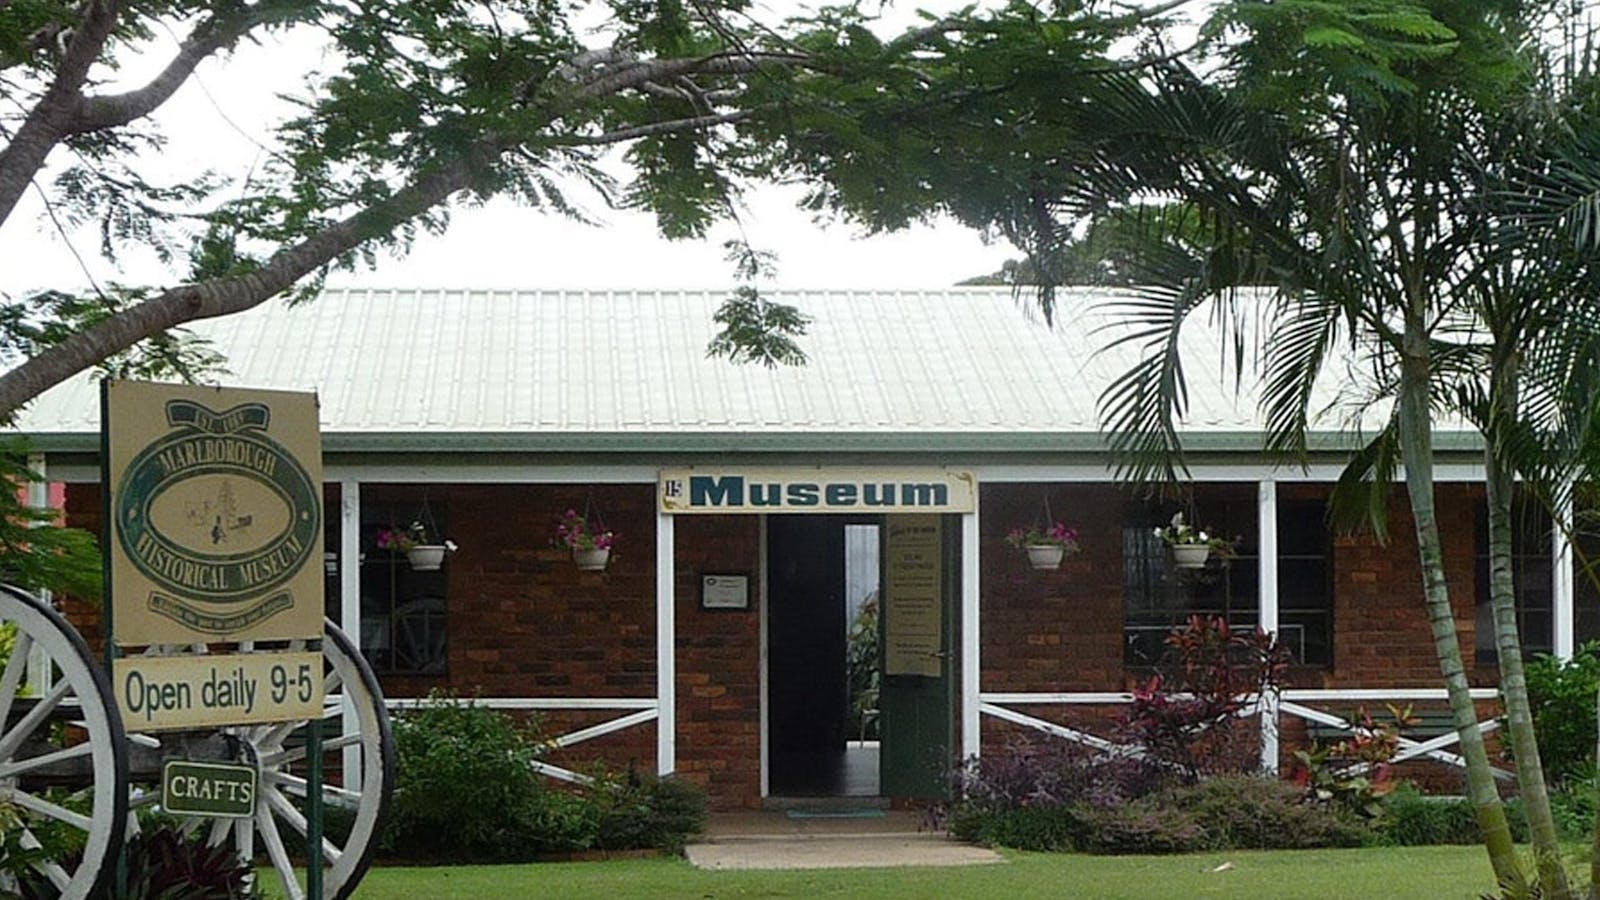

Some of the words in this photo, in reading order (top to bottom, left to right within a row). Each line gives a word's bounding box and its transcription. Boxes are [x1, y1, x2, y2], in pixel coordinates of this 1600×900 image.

[160, 438, 277, 476] MARLBOROUGH
[689, 476, 948, 507] Museum
[136, 531, 229, 589] HISTORICAL
[240, 535, 303, 585] MUSEUM
[125, 670, 191, 721] Open
[202, 667, 256, 713] daily
[270, 664, 312, 704] 9-5
[170, 775, 251, 803] CRAFTS
